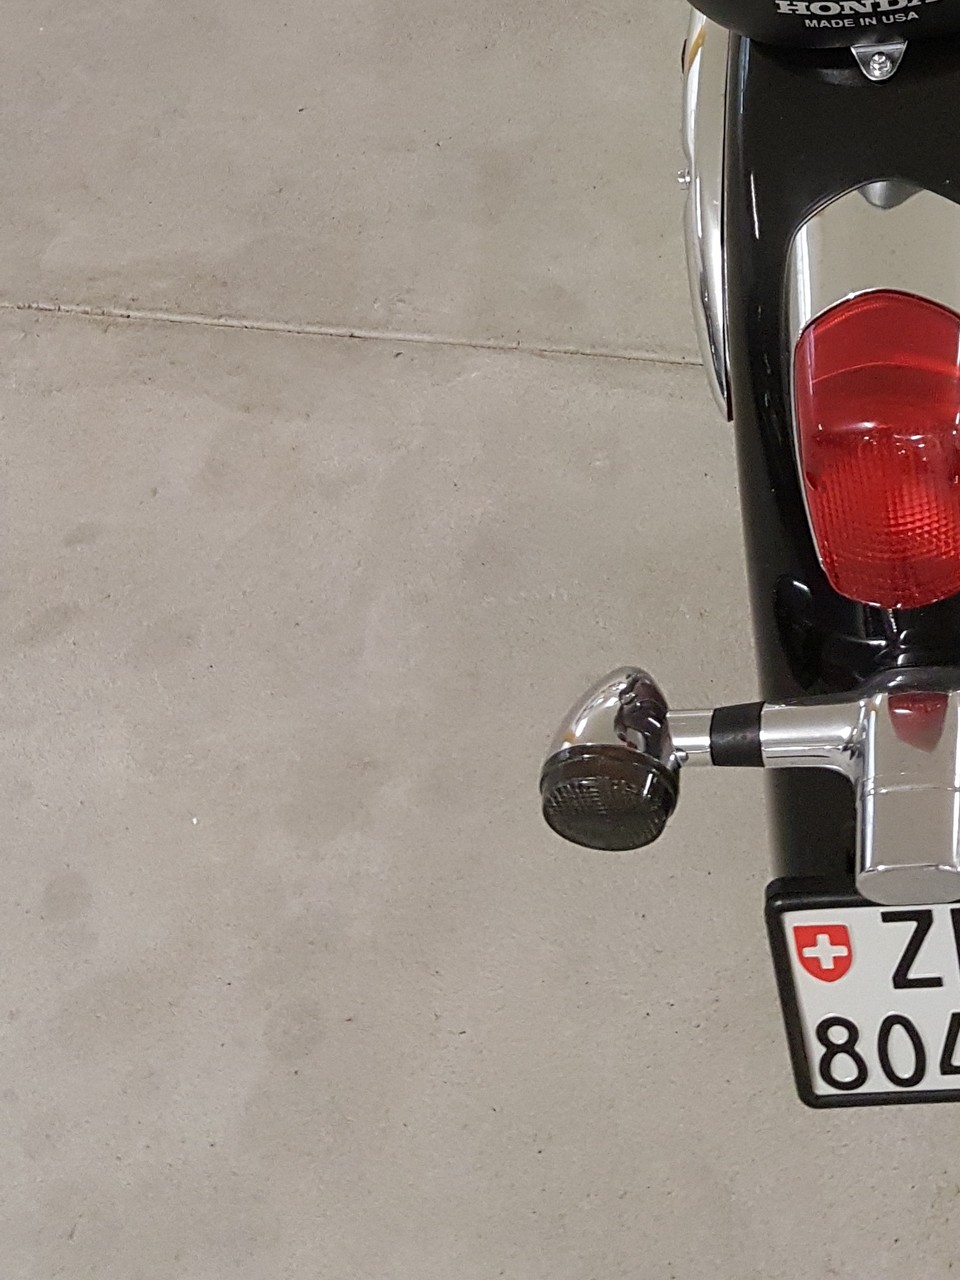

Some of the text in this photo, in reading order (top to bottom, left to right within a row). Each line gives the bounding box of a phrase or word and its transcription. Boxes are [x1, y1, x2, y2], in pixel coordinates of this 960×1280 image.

[804, 11, 920, 29] MADE IN USA
